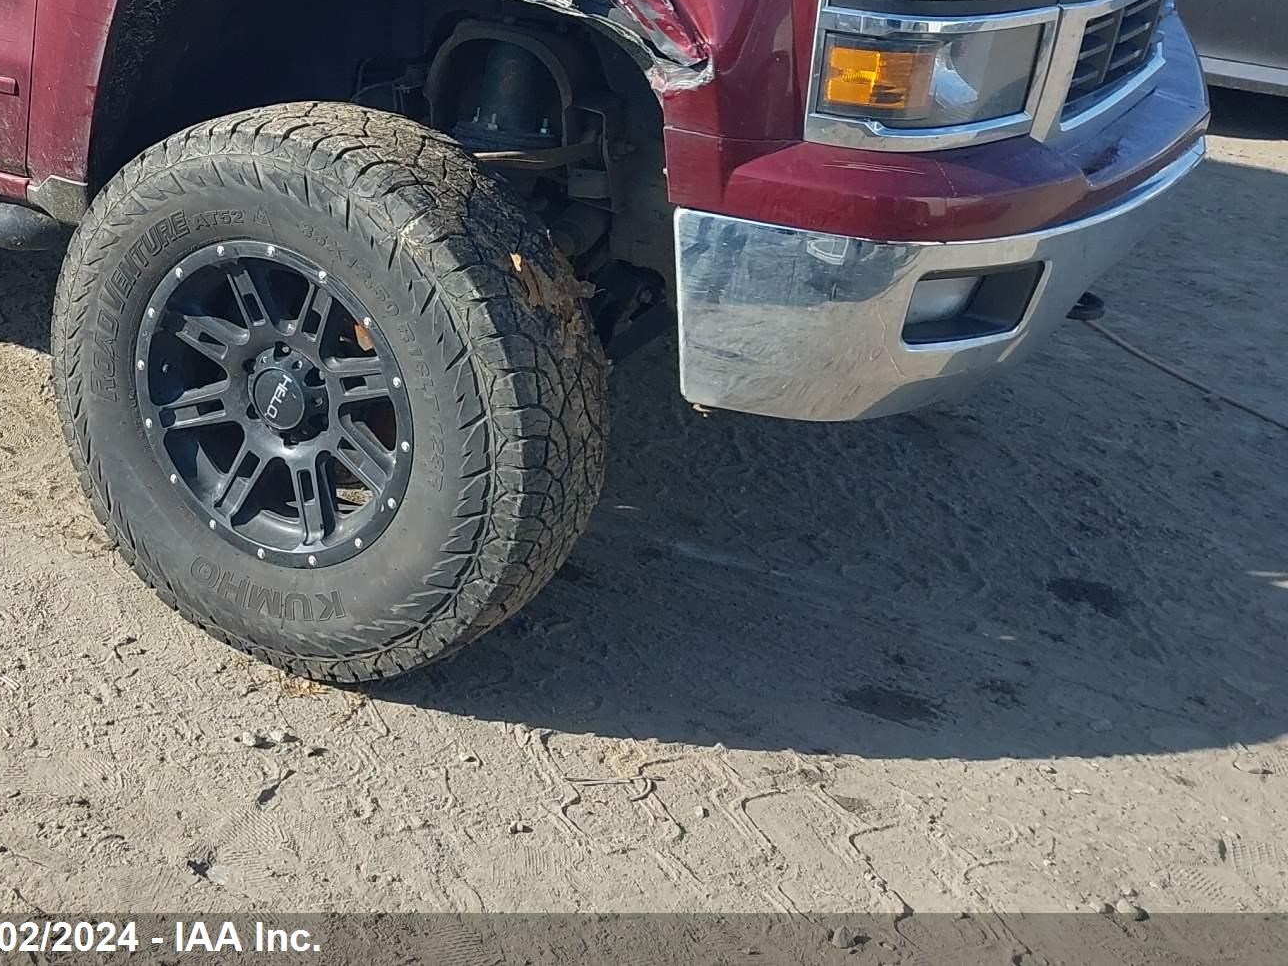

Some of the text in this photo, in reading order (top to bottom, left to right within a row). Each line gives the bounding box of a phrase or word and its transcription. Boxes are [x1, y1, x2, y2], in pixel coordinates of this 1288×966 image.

[101, 209, 190, 313] VENTURE
[194, 210, 244, 231] AT52
[264, 373, 293, 419] HELO
[190, 555, 347, 622] KUMHO
